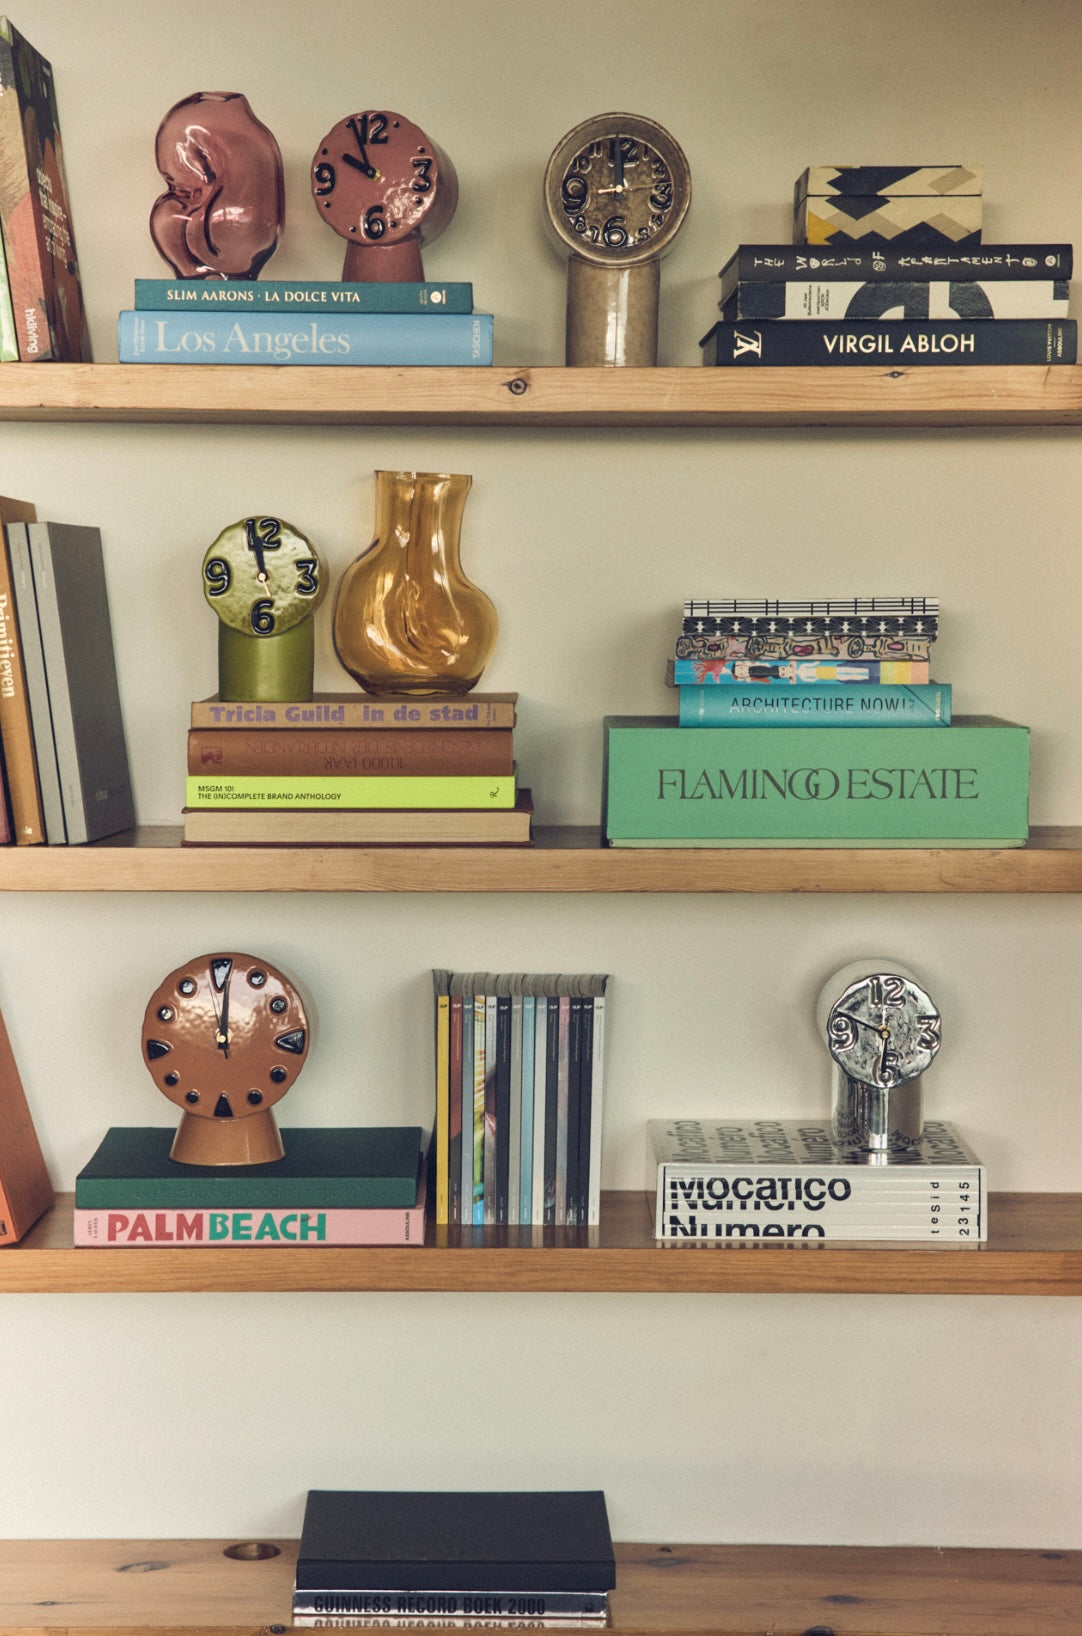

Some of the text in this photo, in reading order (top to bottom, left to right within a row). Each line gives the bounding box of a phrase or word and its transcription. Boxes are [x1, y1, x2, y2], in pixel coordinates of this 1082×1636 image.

[360, 113, 388, 144] 12
[314, 162, 336, 196] 9
[411, 157, 434, 192] 3
[562, 176, 588, 215] 9
[364, 205, 386, 240] 6
[603, 216, 628, 248] 6
[754, 257, 785, 268] THE
[167, 290, 360, 302] SLIM AARONS LA DOLCE VITA
[155, 320, 216, 353] Los
[224, 322, 351, 361] Angeles
[472, 320, 481, 360] TASCHEN
[823, 334, 976, 354] VIRGIL ABLOH
[246, 518, 282, 551] 12
[206, 558, 231, 596] 9
[296, 558, 318, 595] 3
[251, 598, 275, 635] 6
[0, 592, 15, 698] imitieven
[209, 706, 276, 722] Tricia
[285, 705, 345, 722] Guild
[362, 705, 384, 722] in
[393, 704, 421, 722] de
[430, 704, 479, 722] stad
[730, 697, 854, 714] ARCHITECTURE
[860, 697, 906, 713] NOW!
[324, 756, 358, 770] JAAR
[352, 740, 379, 754] DER
[213, 792, 266, 800] (IN)COMPLETE
[657, 768, 980, 800] FLAMINGO ESTATE
[868, 976, 906, 1008] 12
[830, 1014, 858, 1052] 9
[917, 1015, 940, 1052] 3
[107, 1212, 326, 1242] PALM BEACH
[314, 1595, 546, 1615] GUINNESS RECORD BOEK 2000
